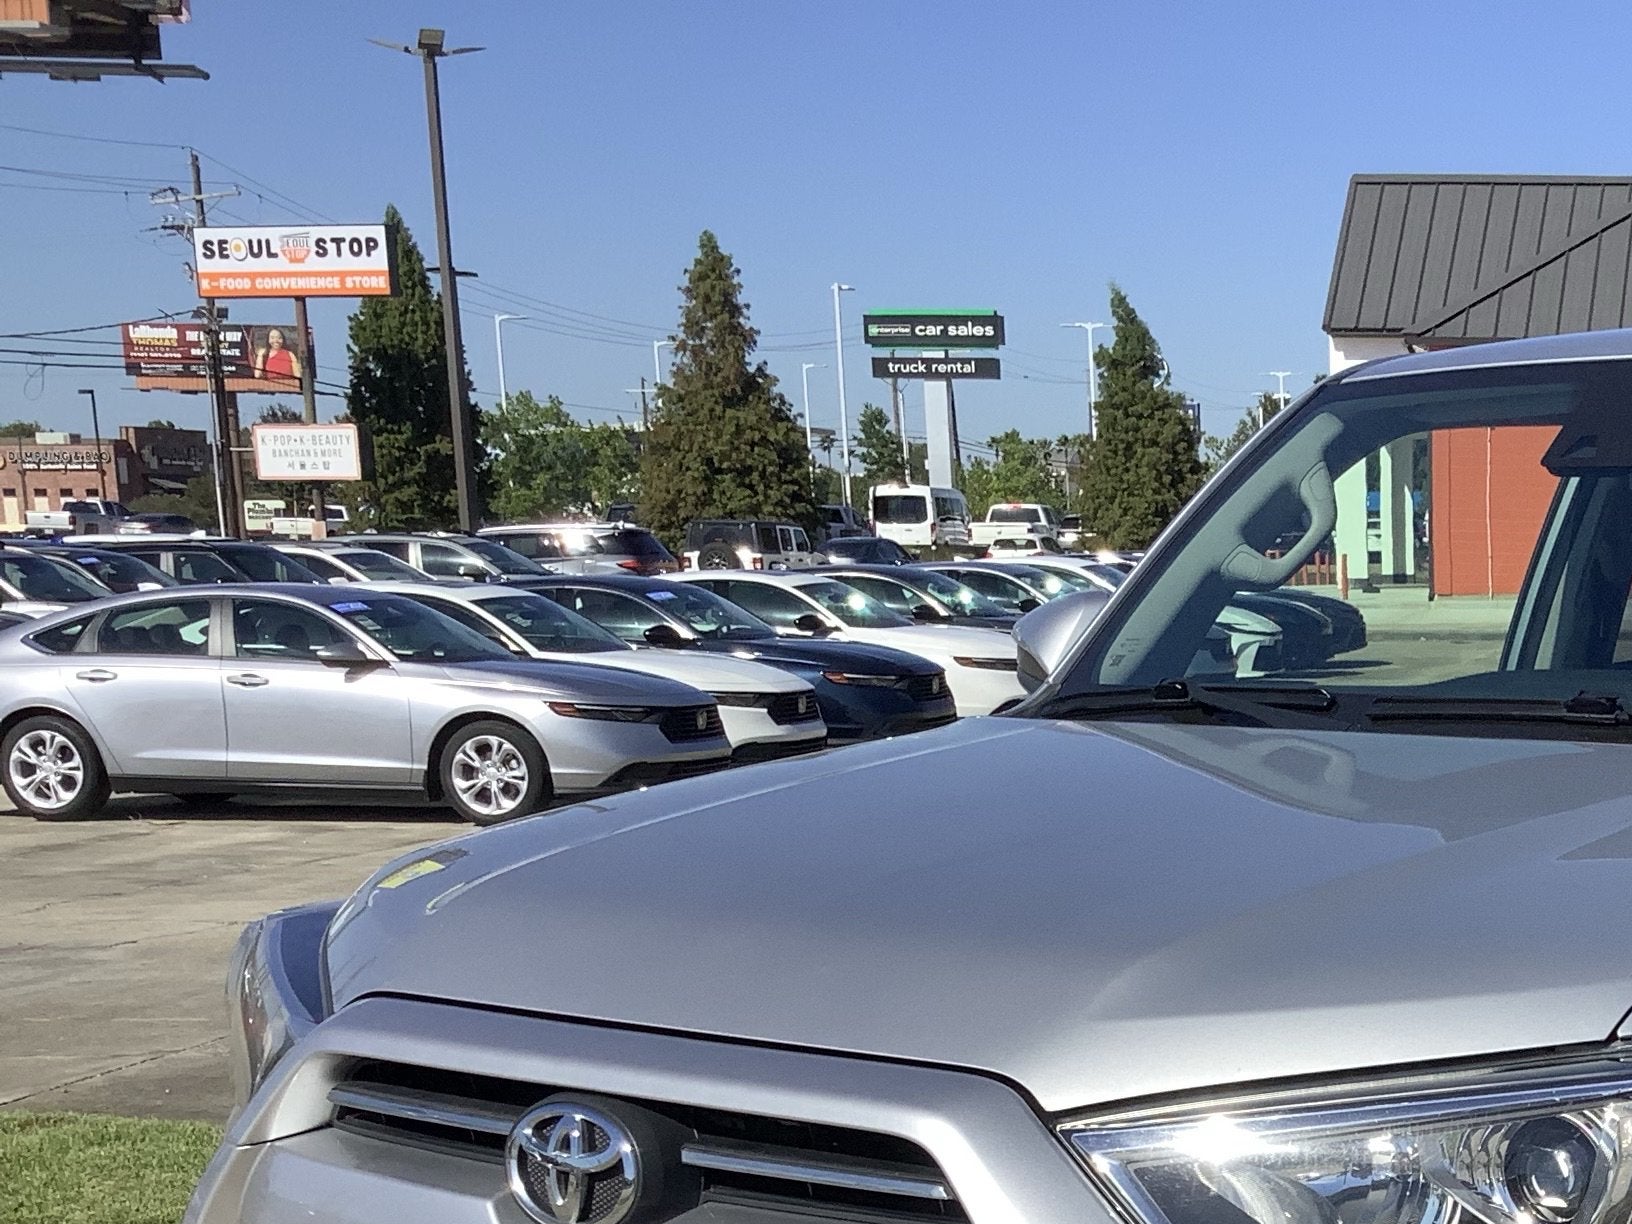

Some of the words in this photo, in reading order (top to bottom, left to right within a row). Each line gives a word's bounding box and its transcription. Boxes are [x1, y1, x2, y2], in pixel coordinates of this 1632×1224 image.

[315, 236, 379, 258] STOP
[201, 278, 251, 290] K-FOOD
[255, 277, 341, 289] CONVENIENCE
[345, 275, 387, 288] STORE
[915, 325, 944, 336] car
[948, 320, 995, 336] sales
[888, 360, 927, 373] truck
[932, 360, 976, 373] rental
[272, 448, 312, 458] BANCHAN
[320, 448, 343, 458] MORE
